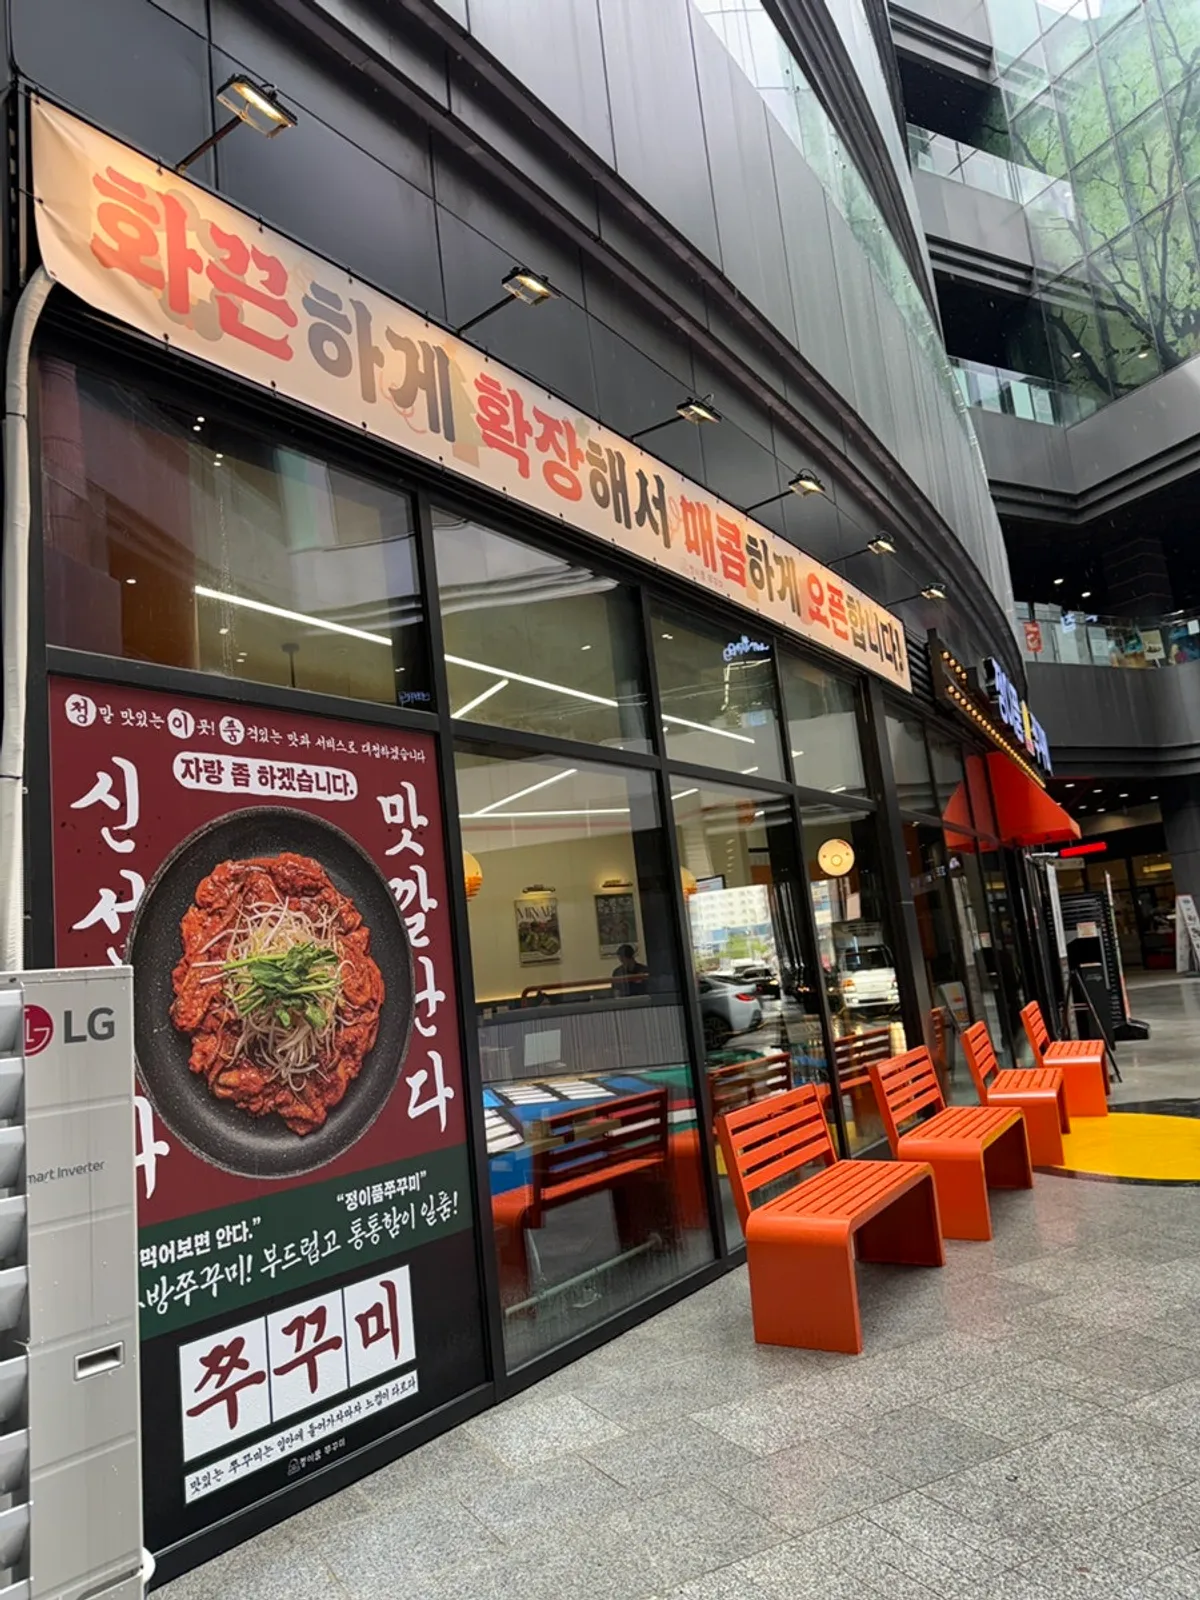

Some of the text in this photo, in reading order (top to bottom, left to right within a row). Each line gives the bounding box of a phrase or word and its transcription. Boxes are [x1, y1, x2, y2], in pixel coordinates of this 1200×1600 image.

[91, 166, 903, 671] 화끈하게 확장해서 매콤하게 오픈합니다!
[69, 696, 114, 725] 정말
[120, 708, 164, 729] 맛있는
[315, 736, 358, 754] 서비스로
[361, 743, 426, 763] 대접하겠습니다
[181, 757, 354, 796] 자랑 좀 하겠습니다.
[63, 1007, 115, 1044] LG
[27, 1160, 105, 1184] mart Inverter
[138, 1190, 459, 1315] 방쭈꾸미! 부드럽고 통통함이 일품!
[139, 1230, 211, 1269] 먹어보면
[186, 1280, 401, 1430] 쭈꾸미
[190, 1468, 224, 1495] 맛있는
[228, 1445, 274, 1474] 쭈꾸미는
[277, 1428, 304, 1452] 입안에
